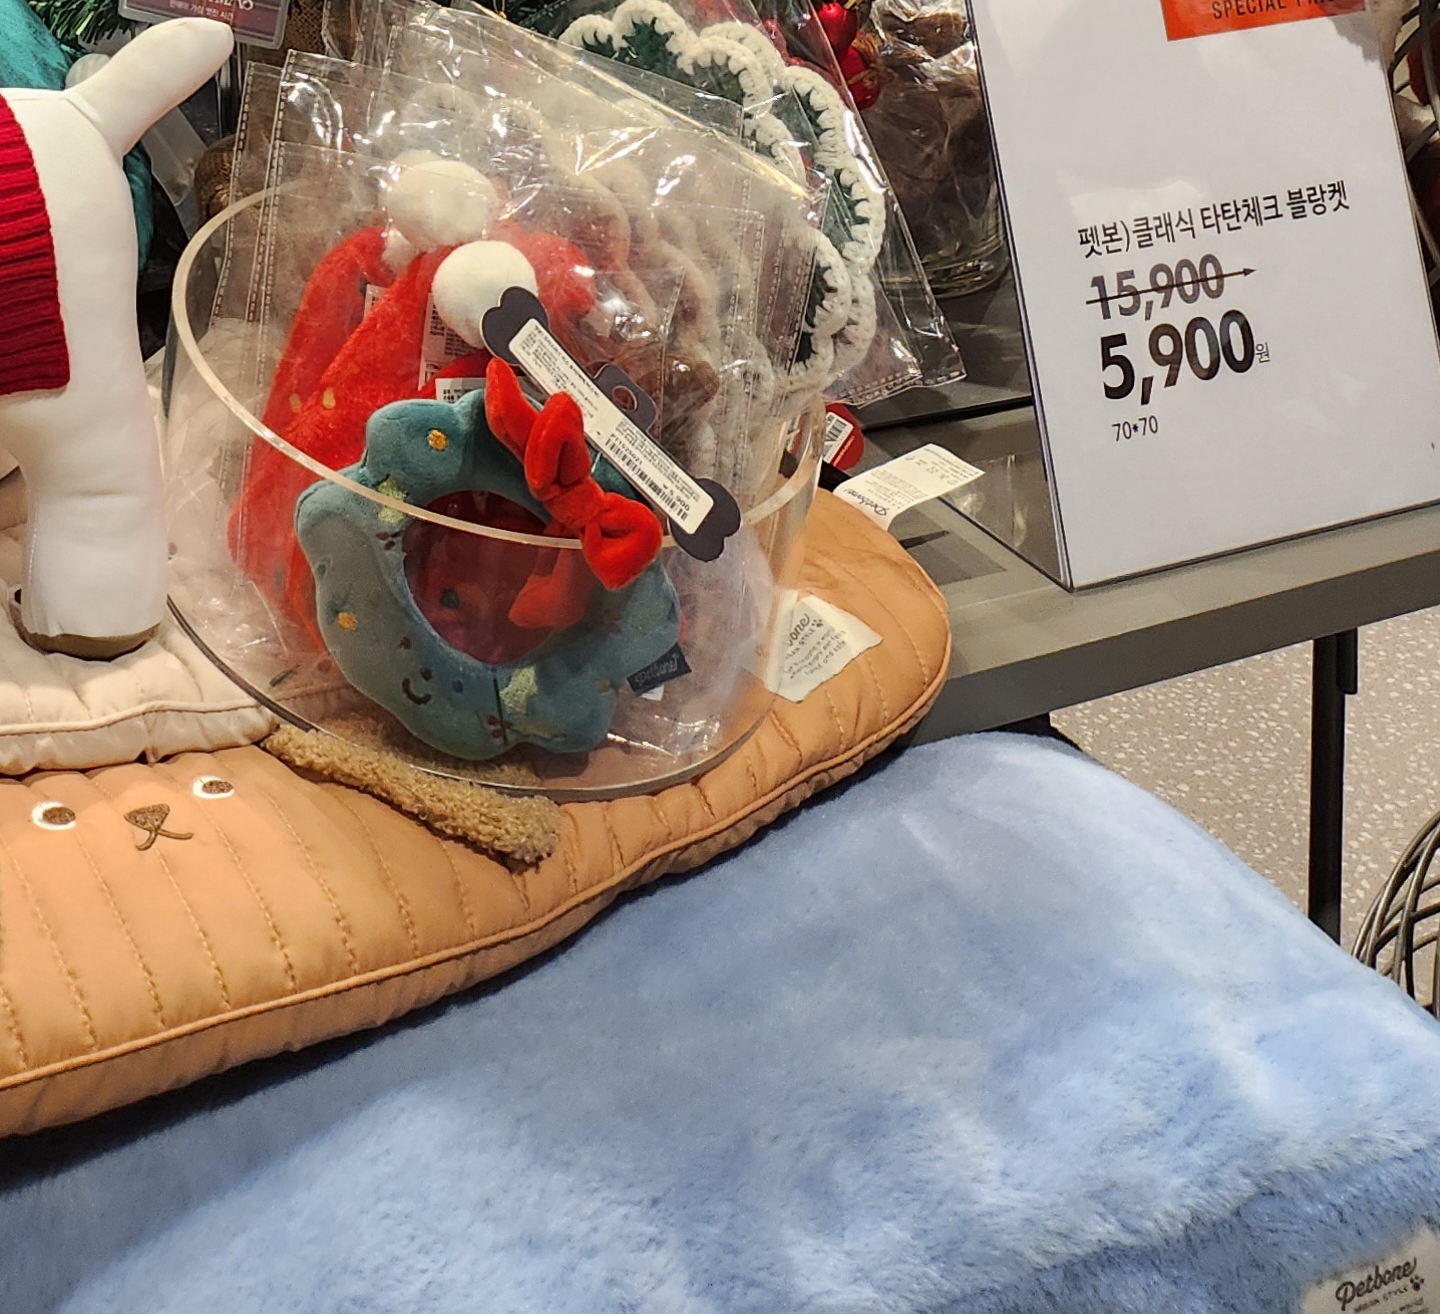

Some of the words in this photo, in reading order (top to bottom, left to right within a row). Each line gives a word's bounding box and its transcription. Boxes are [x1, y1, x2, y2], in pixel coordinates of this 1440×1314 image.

[1200, 195, 1283, 234] 타탄체크
[1286, 180, 1350, 220] 블랑켓
[1090, 254, 1225, 321] 15,900
[1336, 1257, 1417, 1311] Petbone
